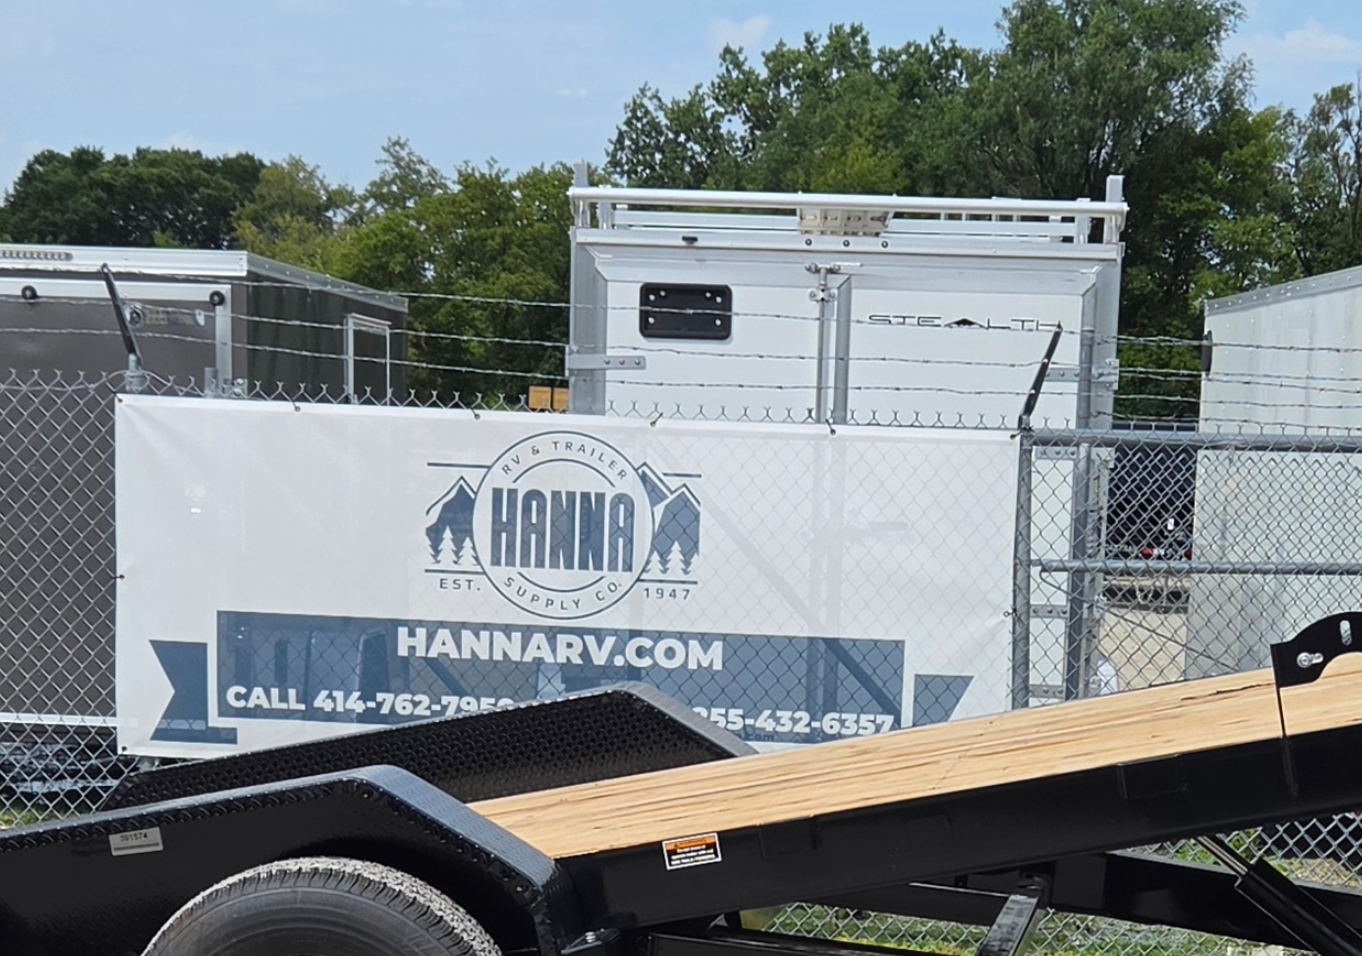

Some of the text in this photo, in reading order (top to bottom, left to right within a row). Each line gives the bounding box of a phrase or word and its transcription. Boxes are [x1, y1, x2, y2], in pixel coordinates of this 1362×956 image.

[501, 440, 628, 481] RV & TRAILER
[490, 487, 635, 573] HANNA
[439, 578, 482, 592] EST.
[503, 577, 623, 611] SUPPLY CO.
[643, 587, 692, 601] 1947
[397, 626, 724, 671] HANNARV.COM
[226, 685, 306, 711] CALL
